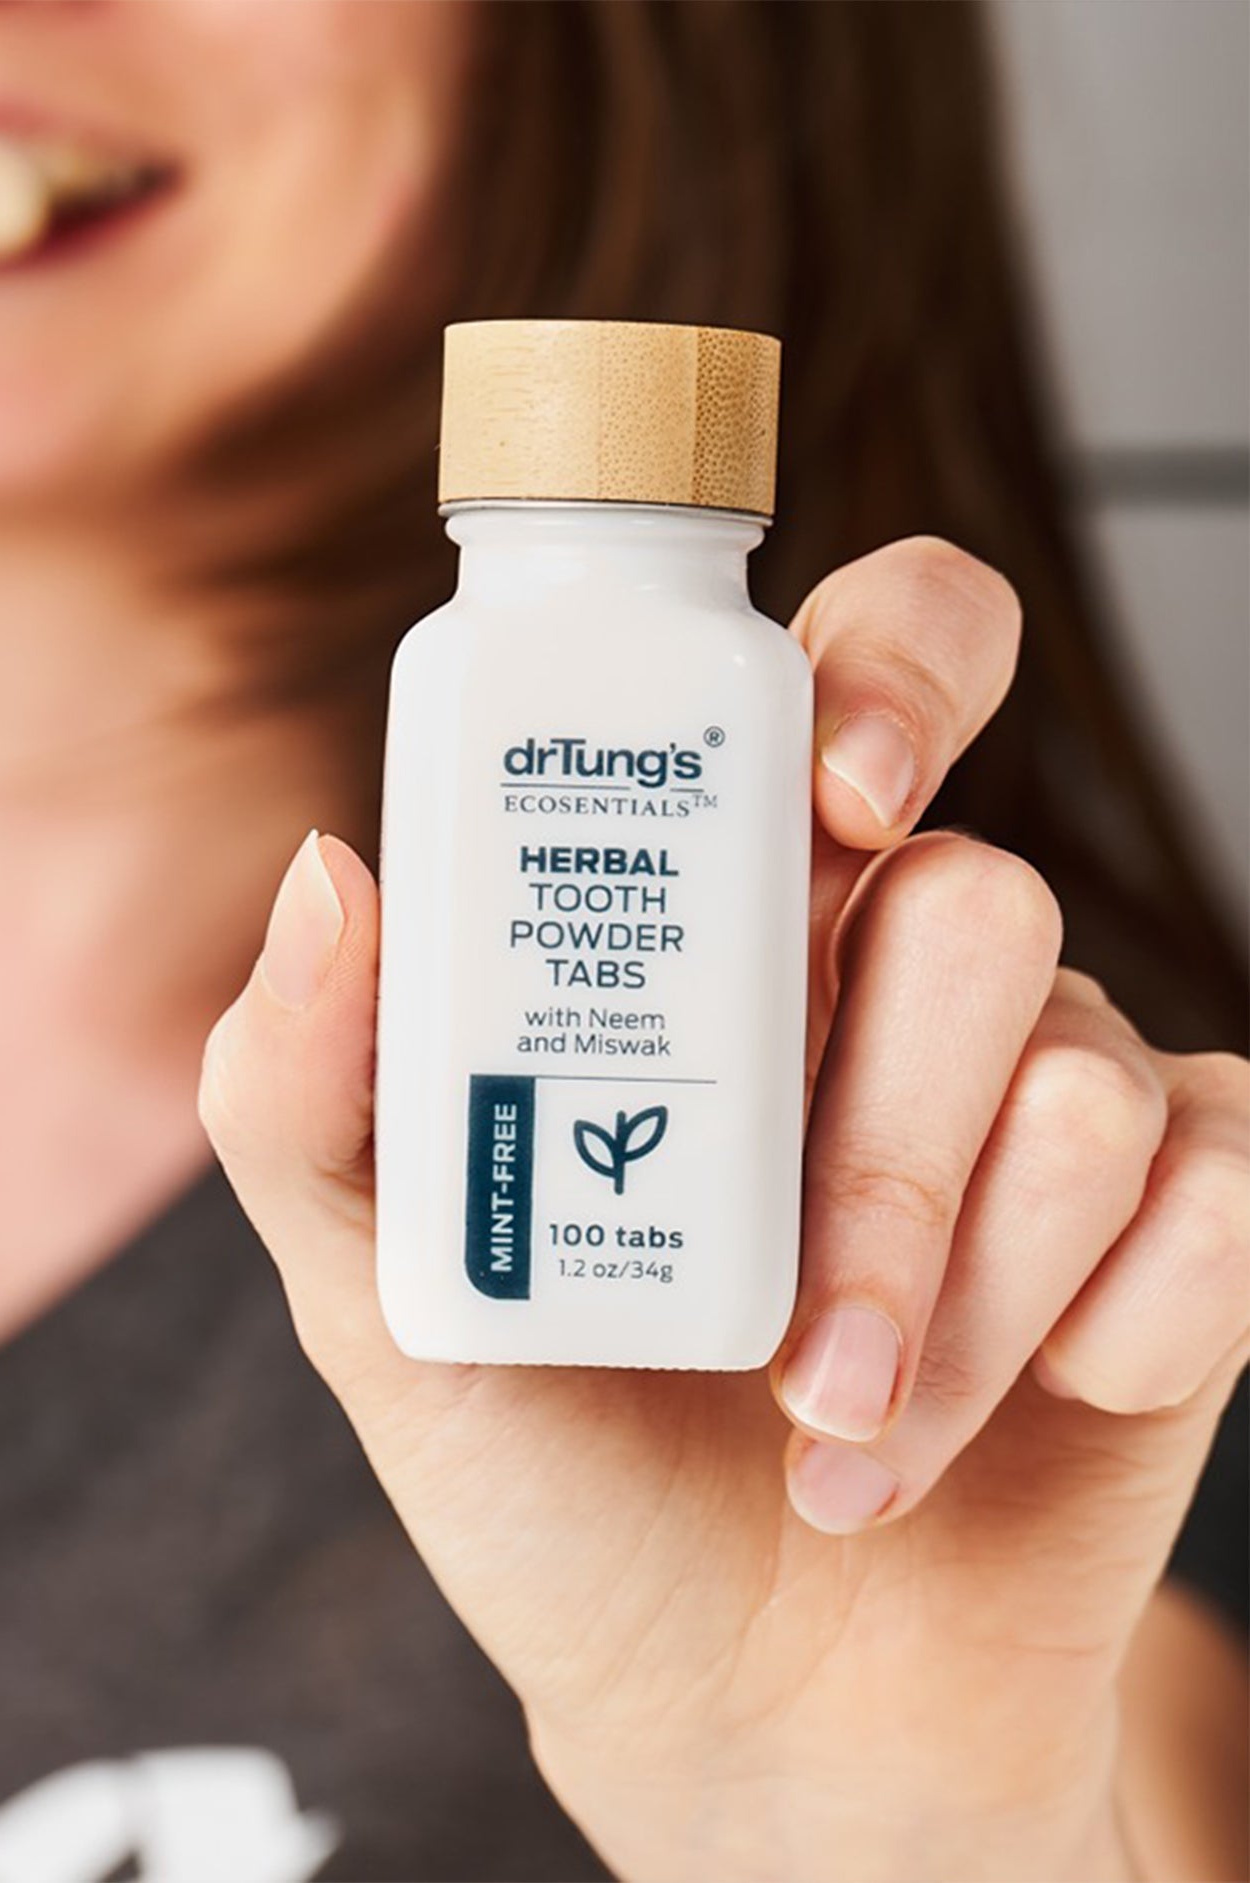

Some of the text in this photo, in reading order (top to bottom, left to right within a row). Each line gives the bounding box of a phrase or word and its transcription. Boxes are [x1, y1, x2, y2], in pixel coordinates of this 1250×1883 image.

[519, 846, 680, 877] HERBAL
[528, 882, 666, 914] TOOTH
[510, 920, 685, 952] POWDER
[545, 958, 646, 990] TABS
[524, 1007, 666, 1031] with Neem
[516, 1033, 671, 1057] and Miswak
[490, 1103, 517, 1273] MINT-FREE
[549, 1224, 684, 1249] 100 tabs
[558, 1259, 674, 1284] 1.2 oz/34g
